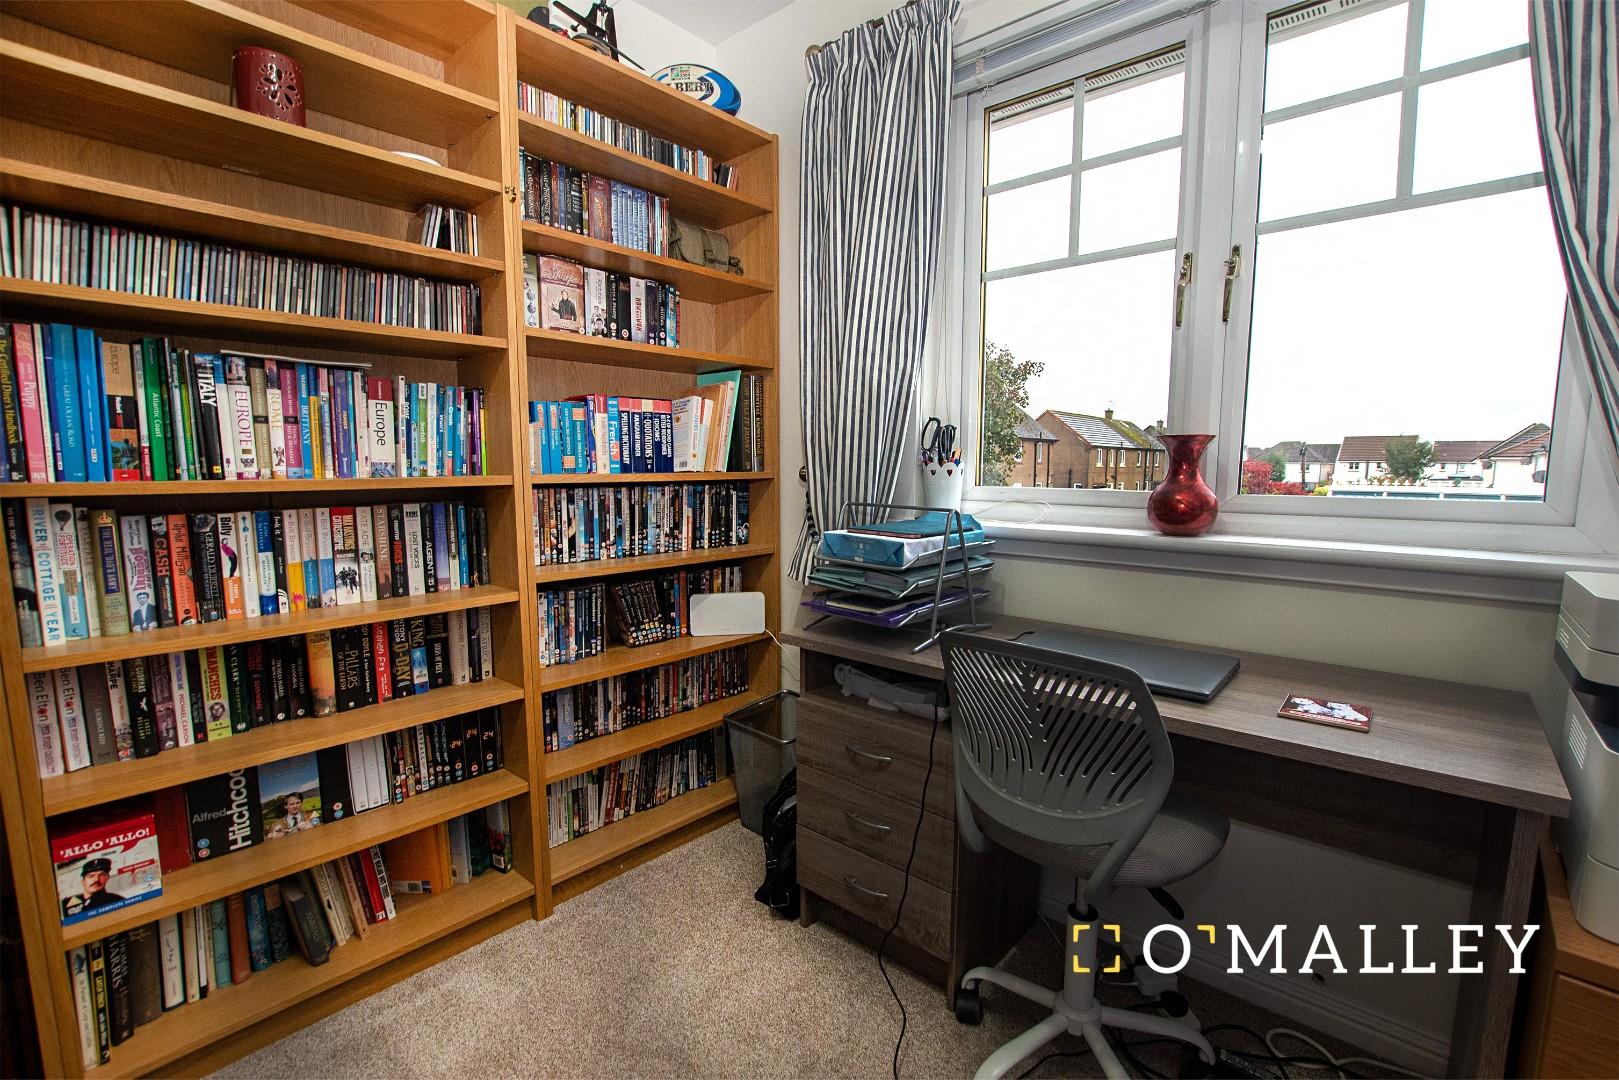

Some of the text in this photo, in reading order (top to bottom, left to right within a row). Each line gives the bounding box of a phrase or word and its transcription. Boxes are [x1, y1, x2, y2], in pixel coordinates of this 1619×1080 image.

[666, 81, 711, 93] BERT
[22, 381, 37, 409] Puppy
[152, 393, 161, 417] Atlantic
[198, 373, 216, 407] ITALY
[6, 410, 18, 444] Handbook
[235, 391, 252, 446] EUROPE
[270, 393, 282, 432] ROME
[302, 406, 310, 445] BRITTANY
[373, 402, 387, 446] Europe
[610, 421, 619, 455] French
[644, 420, 652, 457] QUOTATIONS
[220, 517, 232, 536] Billy
[332, 516, 343, 551] CATASTROPHE
[344, 527, 355, 550] HASTINGS
[361, 530, 370, 546] ADIE
[377, 509, 388, 561] STARSHINE
[58, 535, 69, 566] FORTITUDE
[66, 534, 76, 566] OPERATION
[155, 538, 170, 576] CASH
[175, 546, 188, 576] Milligan
[206, 533, 216, 563] GERALD
[393, 541, 403, 564] VOICES
[426, 541, 434, 575] AGENT
[32, 509, 60, 641] RIVER COTTAGE YEAR
[411, 619, 424, 647] KING
[106, 662, 118, 689] HARPE
[206, 646, 221, 700] MANCHES
[231, 657, 239, 682] CLARK
[345, 650, 359, 688] PILLARS
[394, 643, 411, 680] D-DAY
[33, 673, 50, 721] Ben Elton
[60, 667, 75, 715] Ben Elton
[466, 728, 477, 738] 24
[483, 730, 494, 740] 24
[192, 768, 252, 850] Alfred Hitchco
[60, 828, 150, 858] 'ALLO 'ALLO!
[98, 900, 124, 913] COMPLETE
